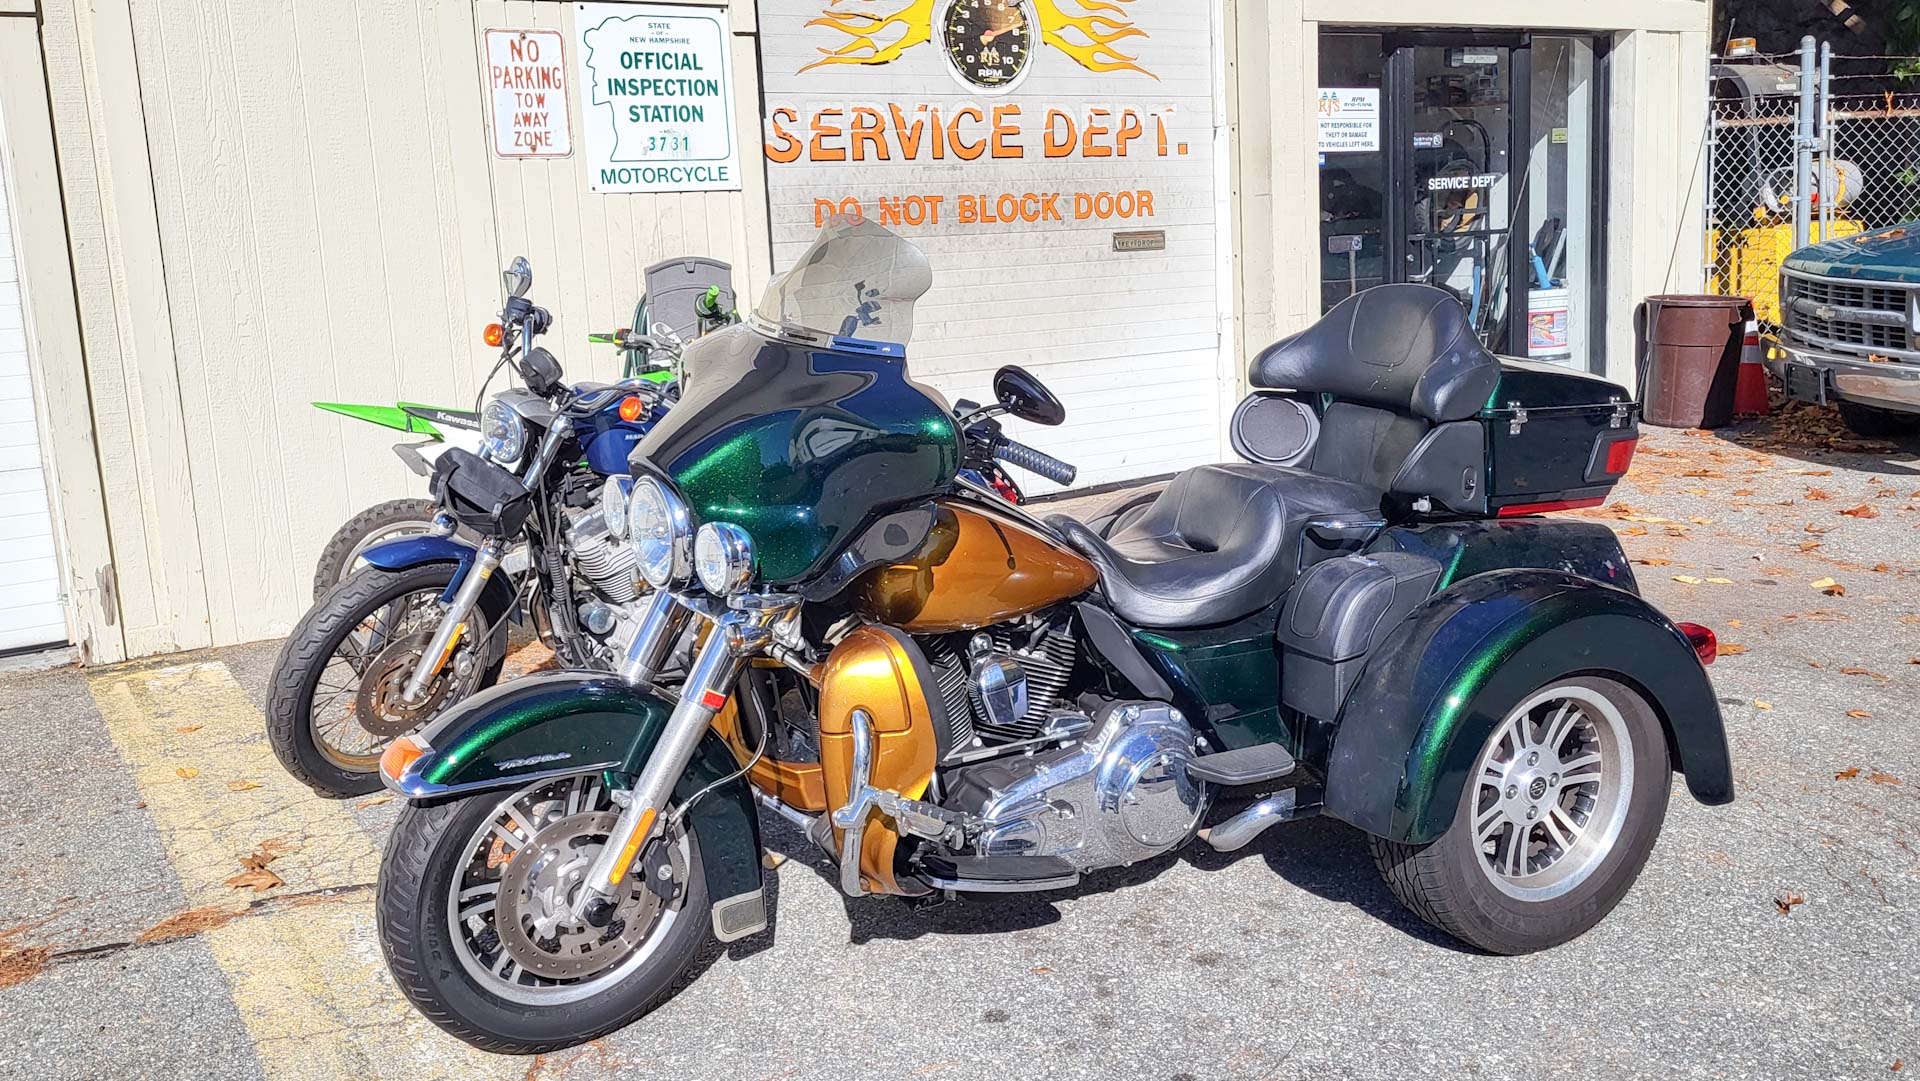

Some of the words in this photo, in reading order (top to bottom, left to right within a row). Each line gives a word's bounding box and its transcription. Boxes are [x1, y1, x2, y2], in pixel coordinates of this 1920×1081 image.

[961, 10, 970, 19] 3
[997, 3, 1005, 11] 6
[648, 22, 671, 30] STATE
[957, 25, 965, 34] 2
[1012, 28, 1020, 36] 8
[629, 36, 647, 44] NEW
[649, 37, 691, 45] HAMPSHIRE
[959, 43, 964, 51] 1
[510, 39, 539, 62] NO
[1011, 44, 1019, 53] 9
[620, 52, 703, 70] OFFICIAL
[966, 55, 975, 63] 0
[1002, 56, 1014, 65] 10
[493, 65, 562, 89] PARKING
[978, 69, 1003, 77] RPM
[607, 78, 719, 96] INSPECTION
[514, 92, 545, 108] TOW
[513, 112, 549, 127] AWAY
[629, 105, 704, 122] STATION
[514, 131, 553, 147] ZONE
[764, 102, 1024, 163] SERVICE
[1043, 105, 1188, 158] DEPT.
[649, 136, 688, 151] 3731
[601, 166, 729, 184] MOTORCYCLE
[1428, 177, 1469, 190] SERVICE
[815, 196, 864, 228] DO
[879, 195, 943, 226] NOT
[958, 192, 1062, 224] BLOCK
[1074, 190, 1154, 219] DOOR
[437, 411, 480, 428] Kawasa
